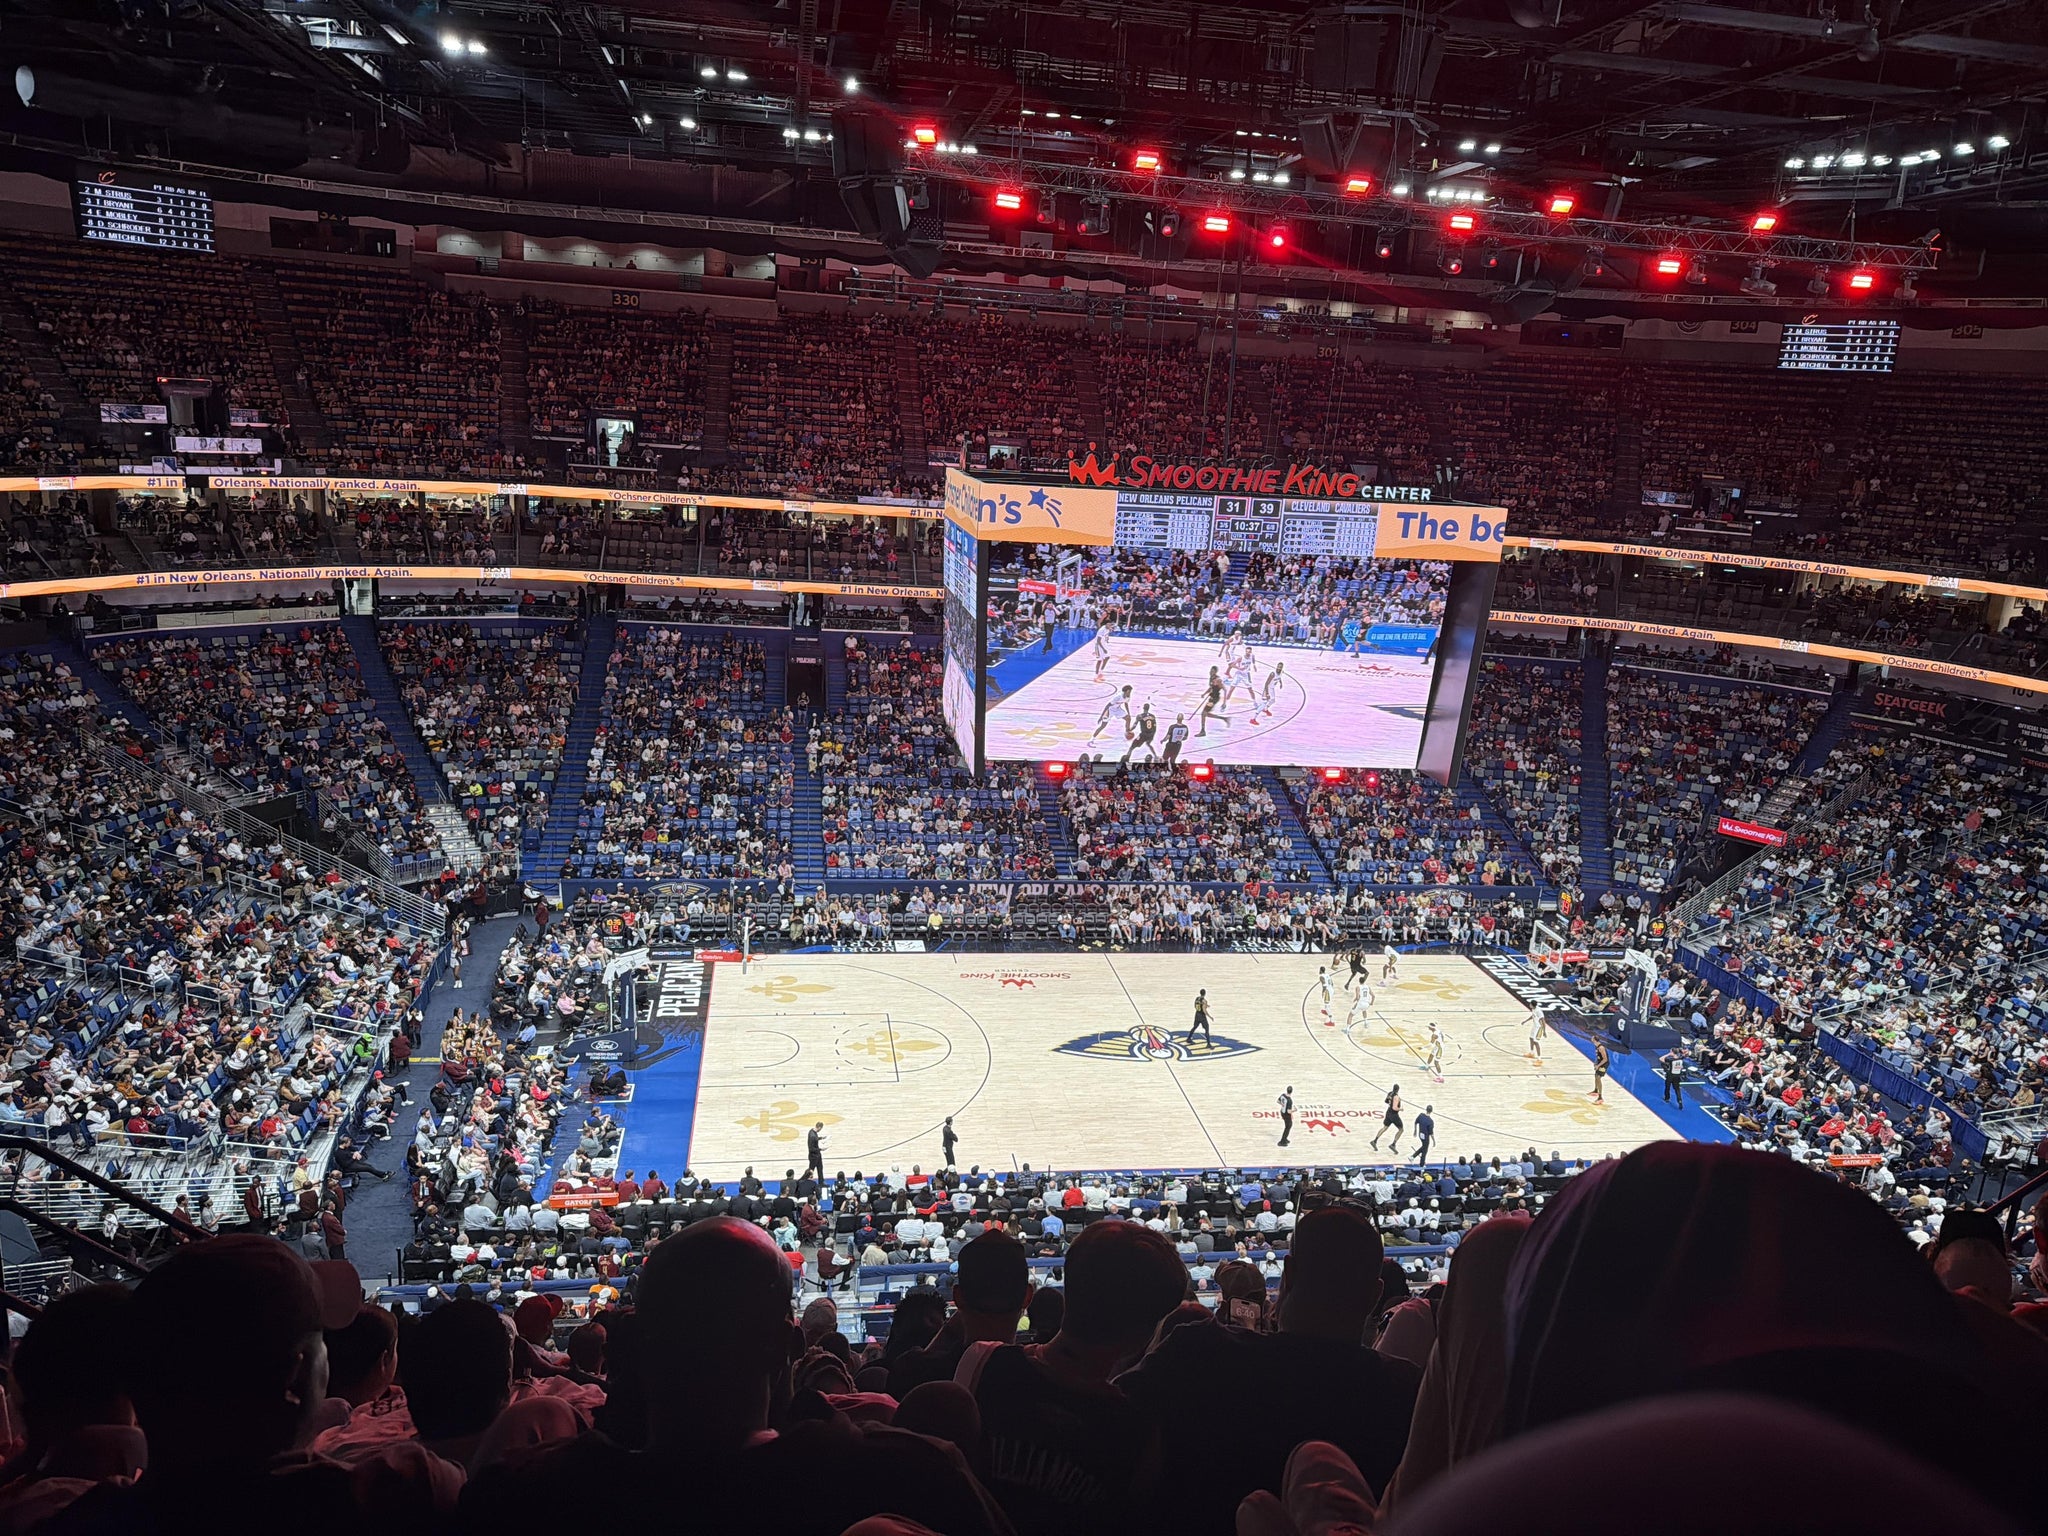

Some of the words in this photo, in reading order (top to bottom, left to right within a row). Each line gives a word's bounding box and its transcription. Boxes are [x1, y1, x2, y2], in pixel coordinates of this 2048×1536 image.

[105, 190, 132, 199] STRUS
[104, 200, 134, 209] BRYANT
[106, 211, 138, 220] MOBLEY
[108, 232, 145, 242] MITCHELL
[613, 294, 639, 306] 330
[980, 313, 1003, 324] 332
[1732, 322, 1757, 330] 304
[1953, 326, 1981, 336] 305
[166, 478, 177, 486] in
[214, 478, 262, 488] Orleans.
[270, 479, 330, 490] Nationally
[334, 480, 375, 489] ranked.
[383, 481, 420, 491] Again.
[614, 492, 651, 501] Ochsner
[653, 494, 697, 504] Children's
[1362, 486, 1431, 501] CENTER
[1118, 494, 1137, 502] NEW
[1140, 495, 1174, 504] ORLEANS
[1176, 497, 1212, 506] PELICANS
[1226, 502, 1240, 512] 31
[1260, 503, 1274, 514] 39
[1292, 502, 1330, 512] CLEVELAND
[1335, 504, 1370, 514] CAVALIERS
[1235, 522, 1260, 530] 10:37
[1397, 512, 1459, 540] The
[1639, 547, 1662, 557] New
[1665, 548, 1708, 561] Orleans.
[1711, 554, 1767, 568] Nationally
[1770, 558, 1809, 569] ranked.
[1814, 561, 1850, 574] Again.
[136, 575, 150, 584] #1
[154, 574, 165, 583] in
[169, 573, 199, 583] New
[203, 572, 255, 582] Orleans.
[260, 568, 322, 580] Nationally
[325, 567, 370, 577] ranked.
[374, 568, 412, 578] Again.
[589, 574, 628, 583] Ochsner
[630, 576, 674, 585] Children's
[867, 587, 890, 595] New
[892, 588, 934, 597] Orleans.
[1514, 613, 1536, 622] New
[1538, 615, 1580, 626] Orleans.
[1583, 618, 1636, 630] Nationally
[1639, 624, 1678, 636] ranked.
[1681, 629, 1715, 640] Again.
[1887, 657, 1929, 671] Ochsner
[1930, 663, 1978, 679] Children's
[1874, 692, 1948, 718] SEATGEEK
[1146, 720, 1152, 729] 8
[1473, 956, 1571, 1012] PELICANS
[656, 963, 704, 1017] PELICAN
[1236, 1308, 1254, 1318] 6:40
